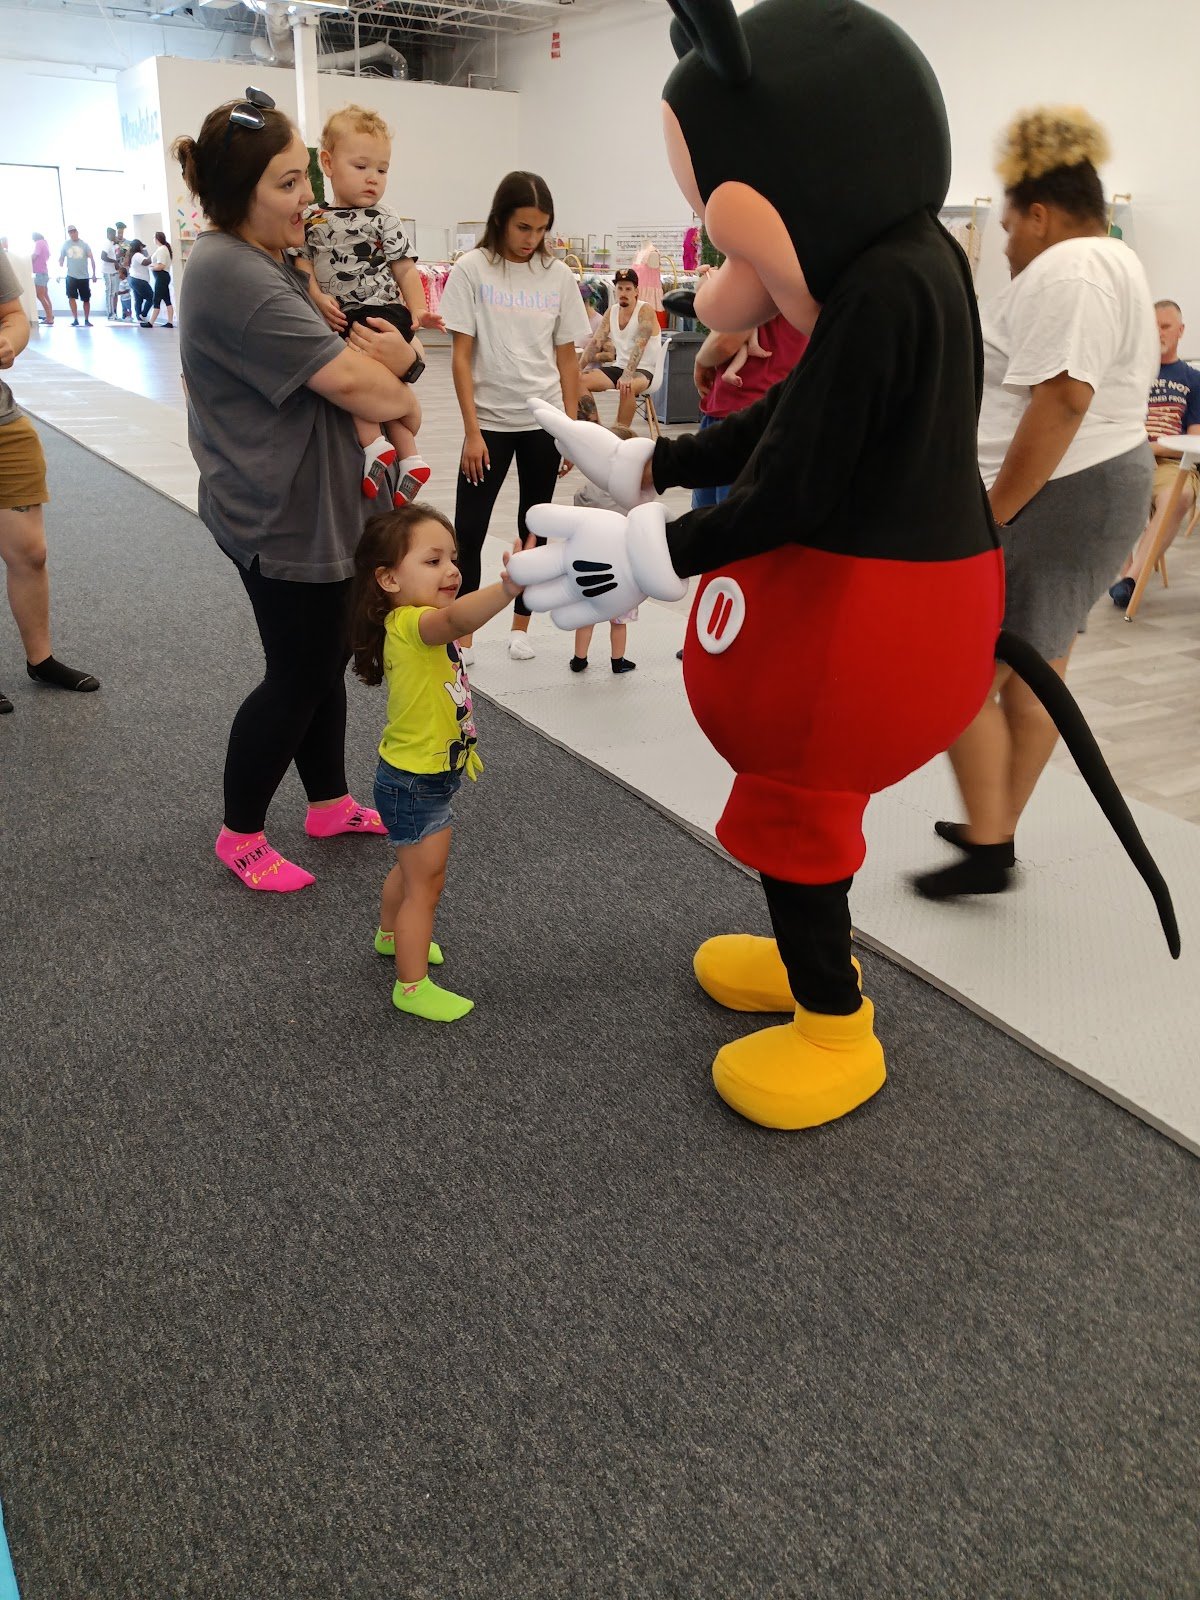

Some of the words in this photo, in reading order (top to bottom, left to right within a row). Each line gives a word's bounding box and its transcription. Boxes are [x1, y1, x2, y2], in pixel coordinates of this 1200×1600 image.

[1152, 379, 1167, 388] RE
[1168, 380, 1191, 396] NOT
[1168, 395, 1187, 405] FROM
